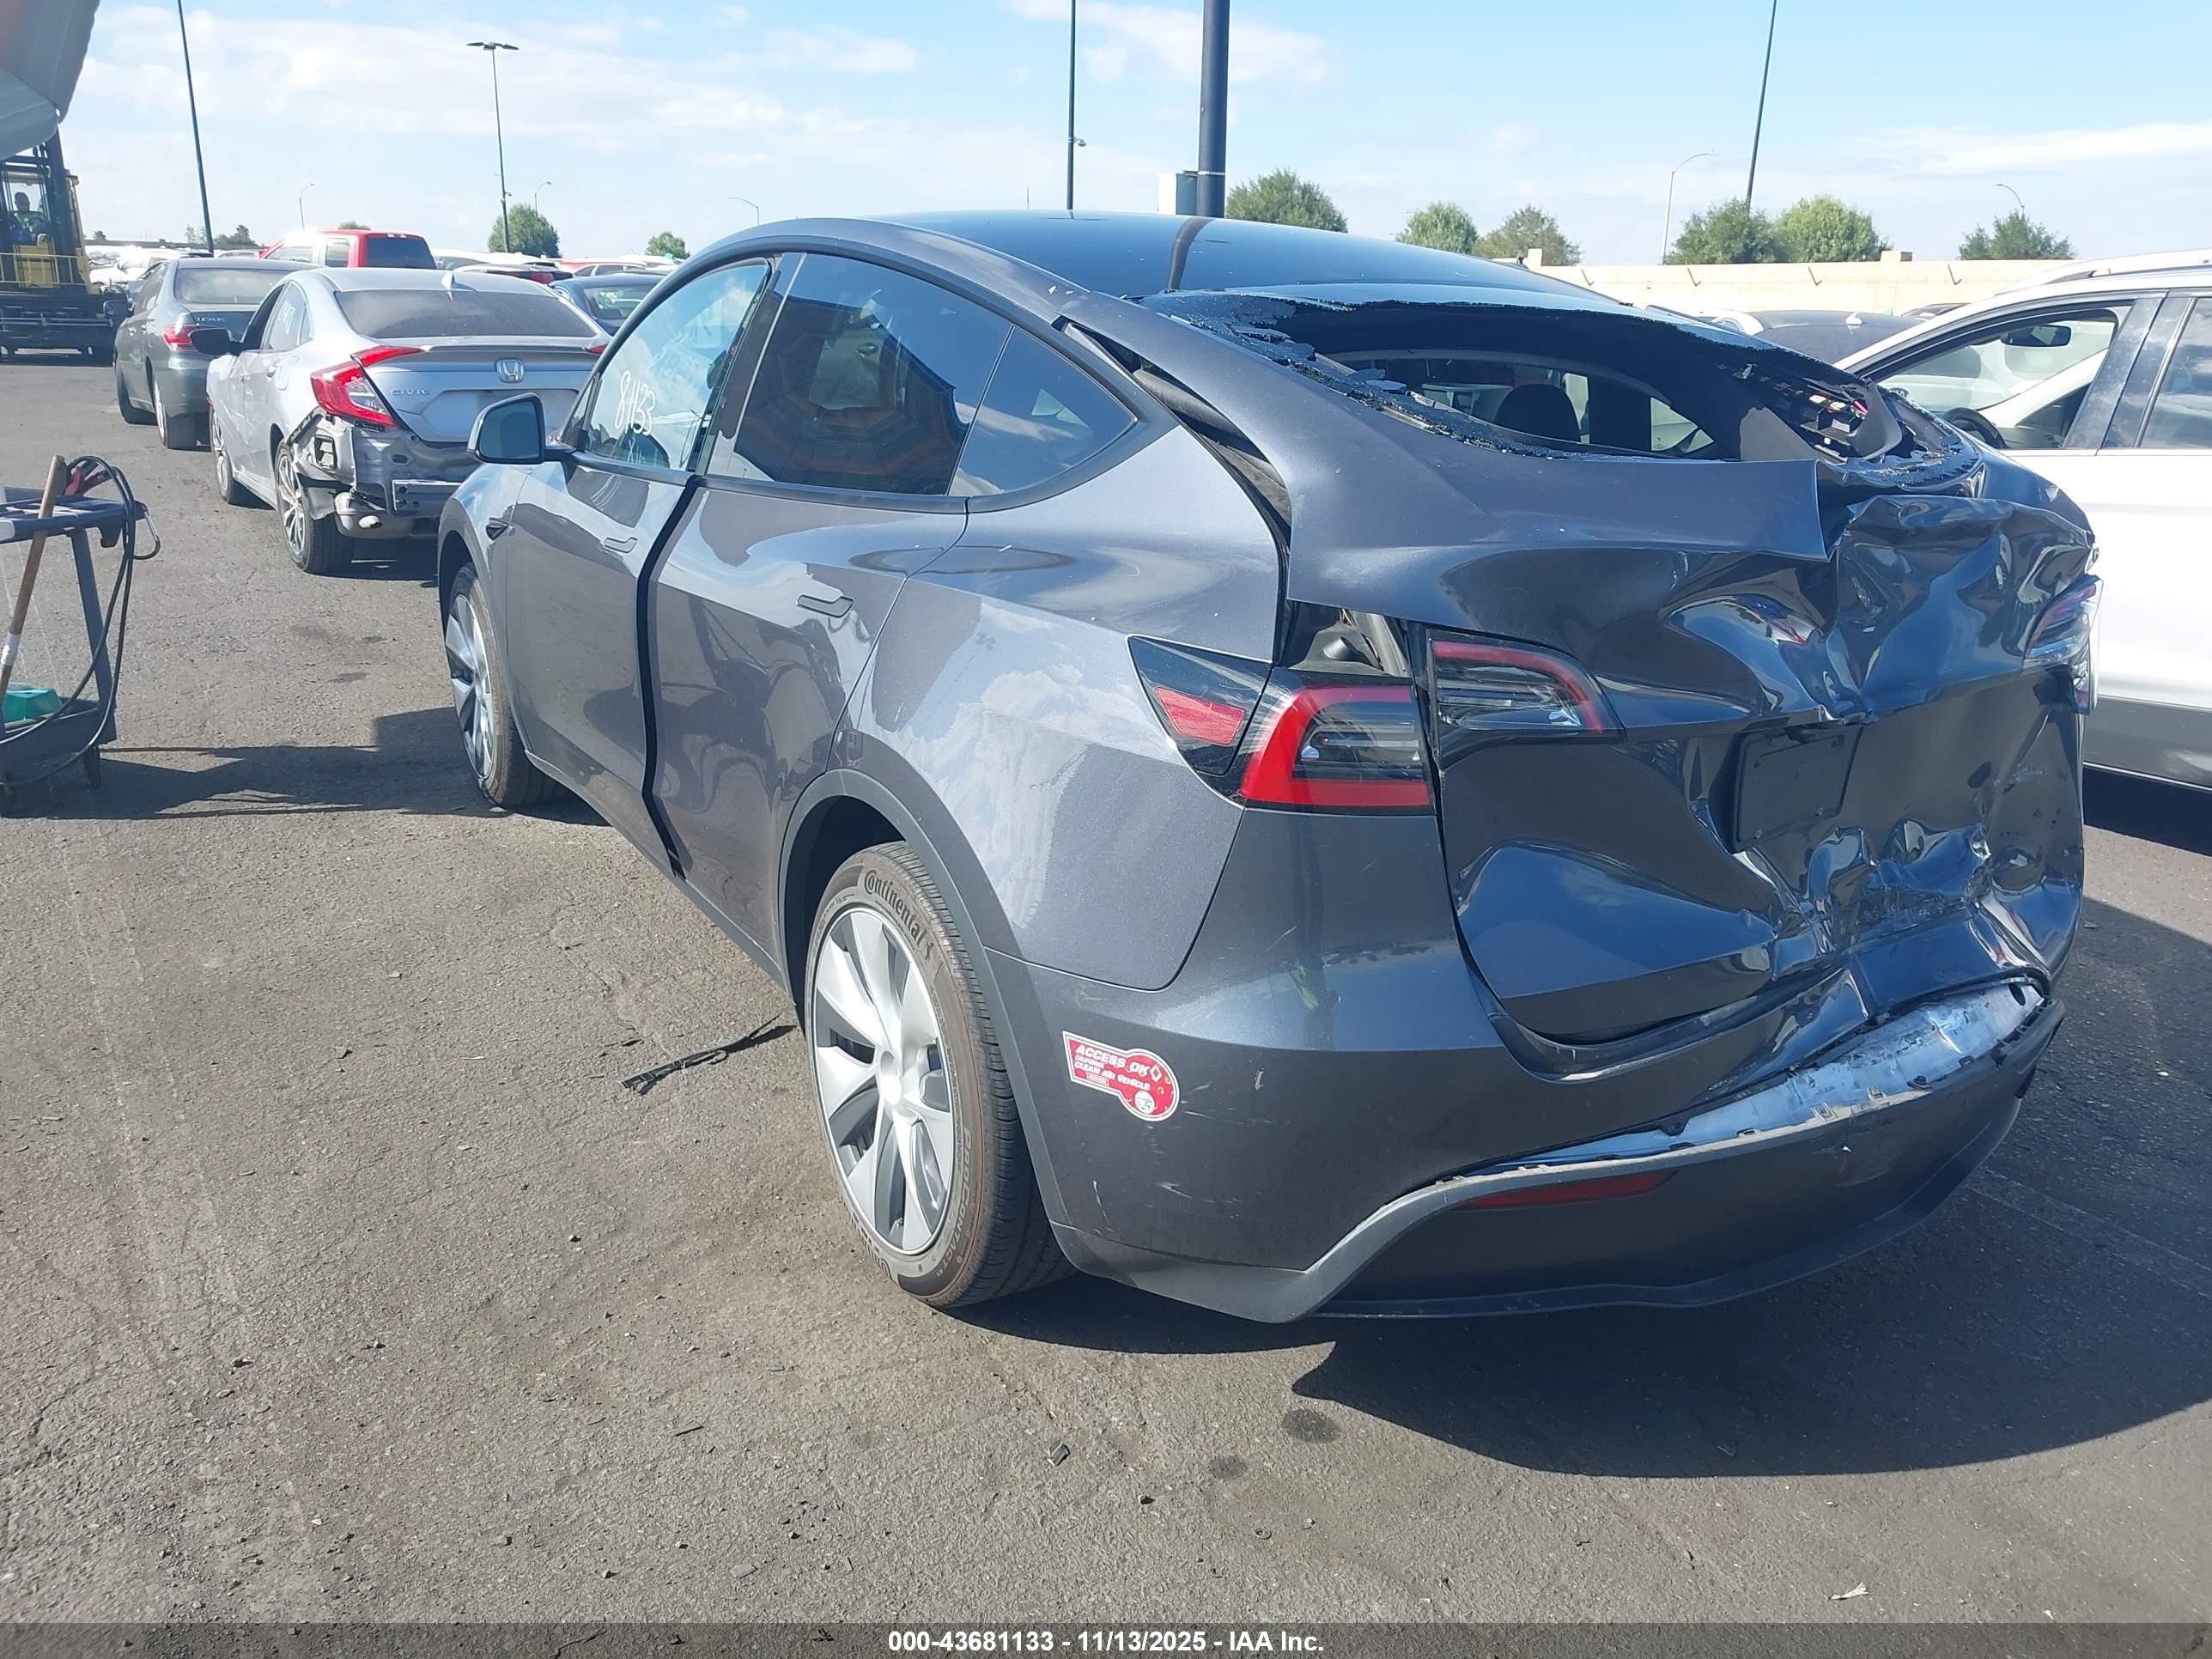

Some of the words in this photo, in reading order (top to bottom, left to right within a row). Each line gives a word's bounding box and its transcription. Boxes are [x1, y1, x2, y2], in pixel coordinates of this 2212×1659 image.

[864, 869, 928, 947] Continental
[1074, 1060, 1101, 1074] CLEAN
[1101, 1069, 1116, 1080] AIR
[1117, 1073, 1151, 1091] VEHICLE
[1075, 1044, 1127, 1069] ACCESS
[1129, 1061, 1151, 1077] OK
